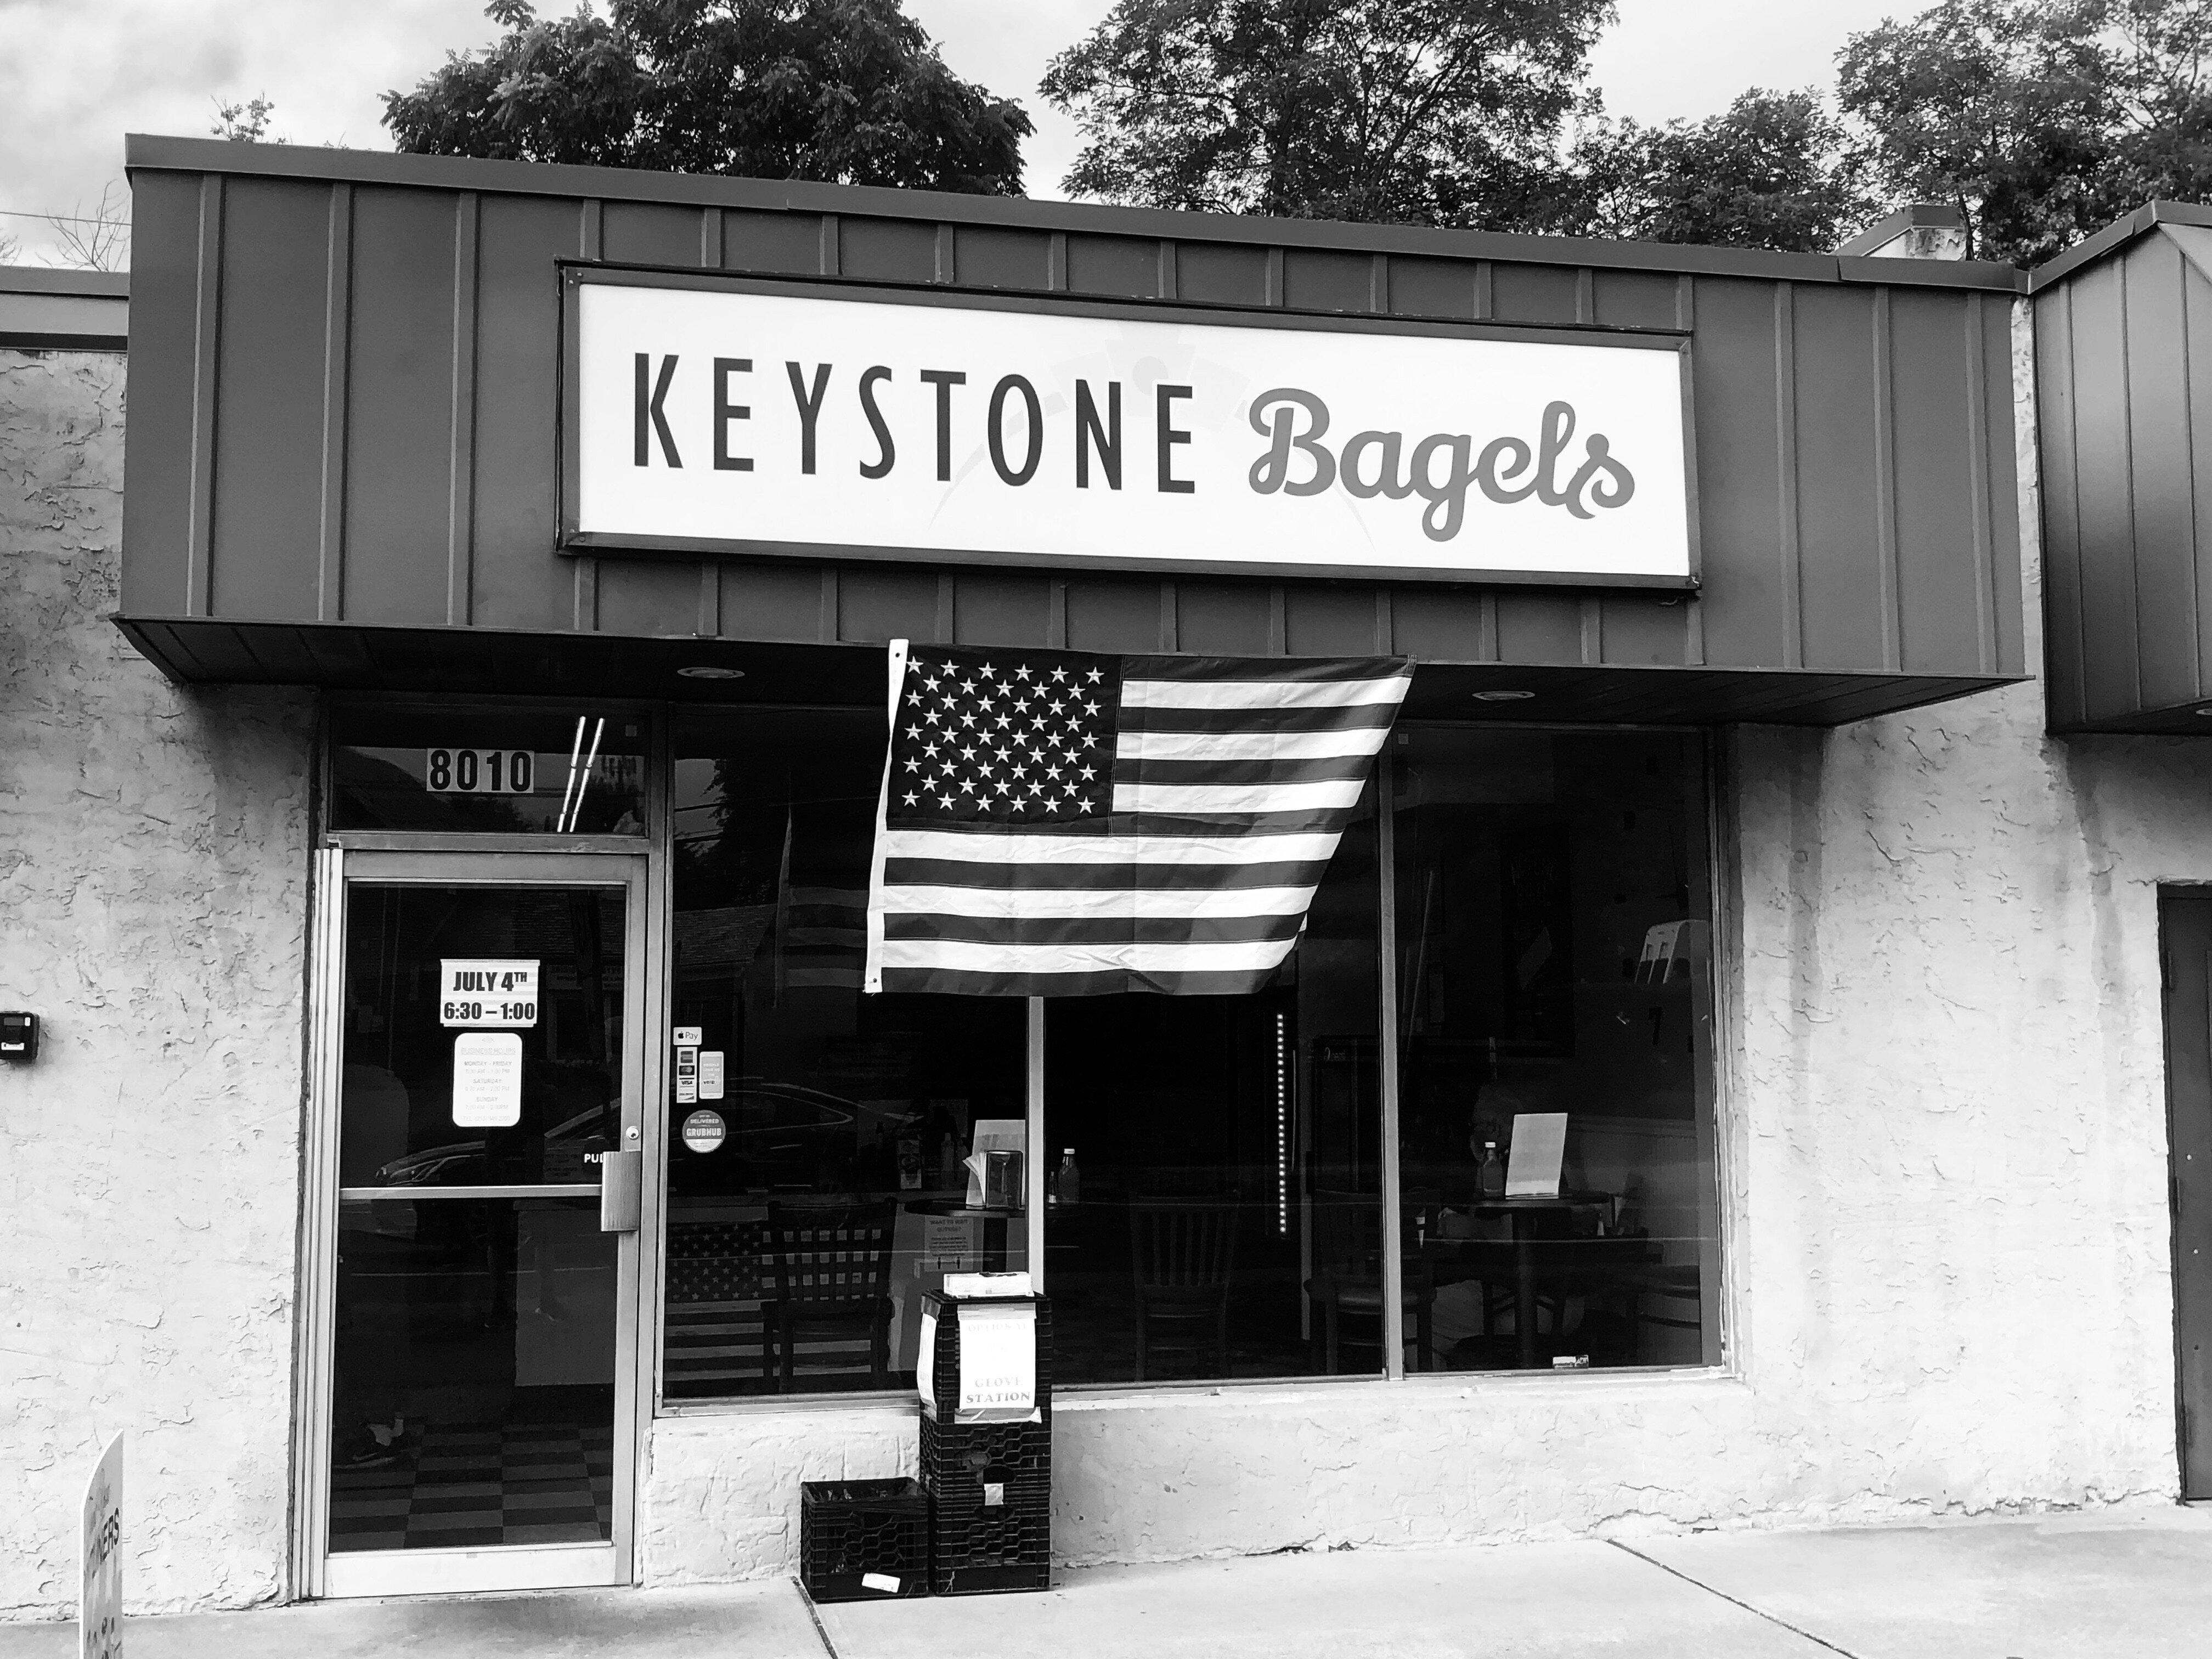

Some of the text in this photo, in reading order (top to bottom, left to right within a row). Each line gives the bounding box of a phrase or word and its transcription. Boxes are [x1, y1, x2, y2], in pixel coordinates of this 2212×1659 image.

[633, 353, 1635, 542] KEYSTONE Bagels
[430, 750, 532, 792] 8010
[453, 972, 498, 991] JULY
[501, 972, 527, 991] 4TH
[444, 1002, 482, 1019] 6:30
[500, 1003, 535, 1020] 1:00
[685, 1031, 698, 1041] Pay
[686, 1127, 722, 1137] GRUBHUB
[975, 1377, 1023, 1388] GLOVE
[966, 1392, 1030, 1404] STATION
